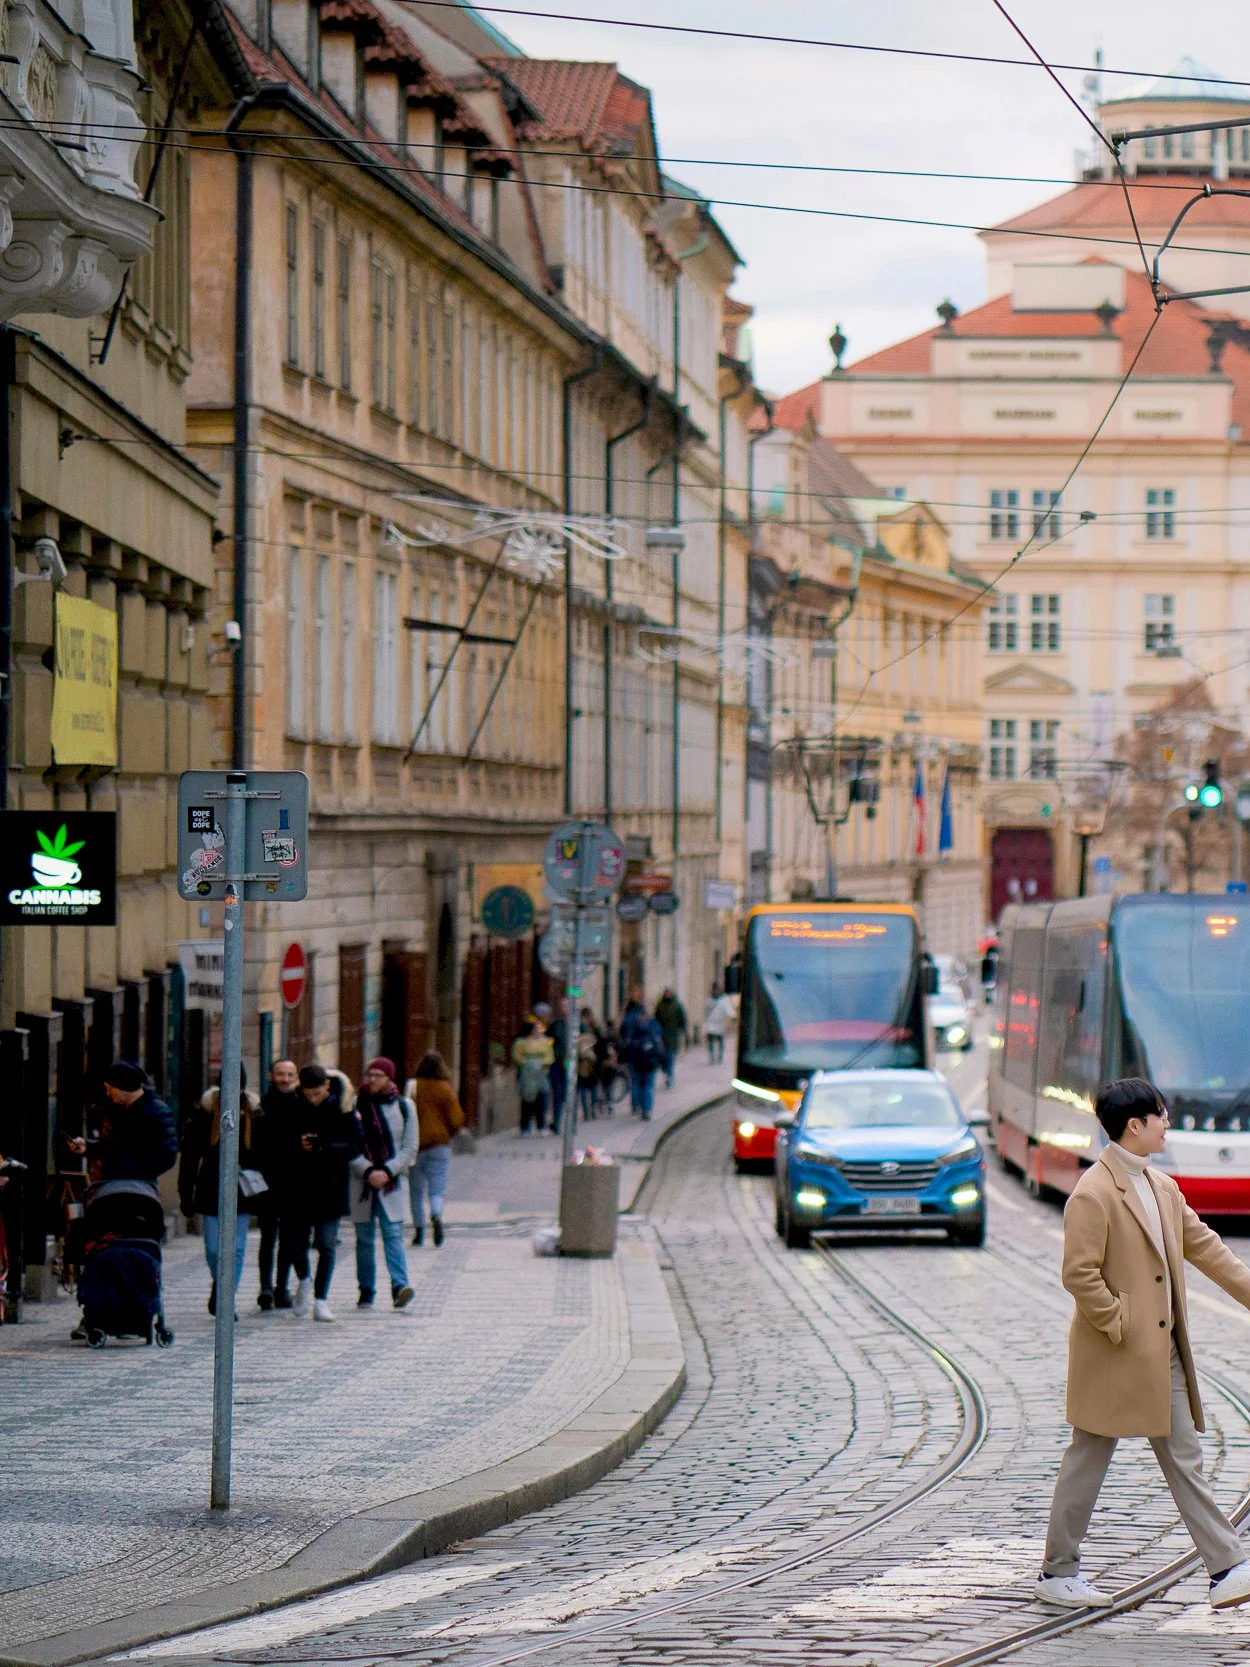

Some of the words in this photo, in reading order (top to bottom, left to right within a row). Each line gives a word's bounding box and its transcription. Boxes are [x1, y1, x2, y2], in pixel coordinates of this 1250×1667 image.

[8, 889, 102, 905] CANNABIS
[22, 905, 46, 915] ITALIAN
[47, 905, 69, 915] COFFEE
[71, 905, 89, 915] SHOP
[188, 983, 225, 999] MARK
[1065, 1584, 1073, 1593] FILA
